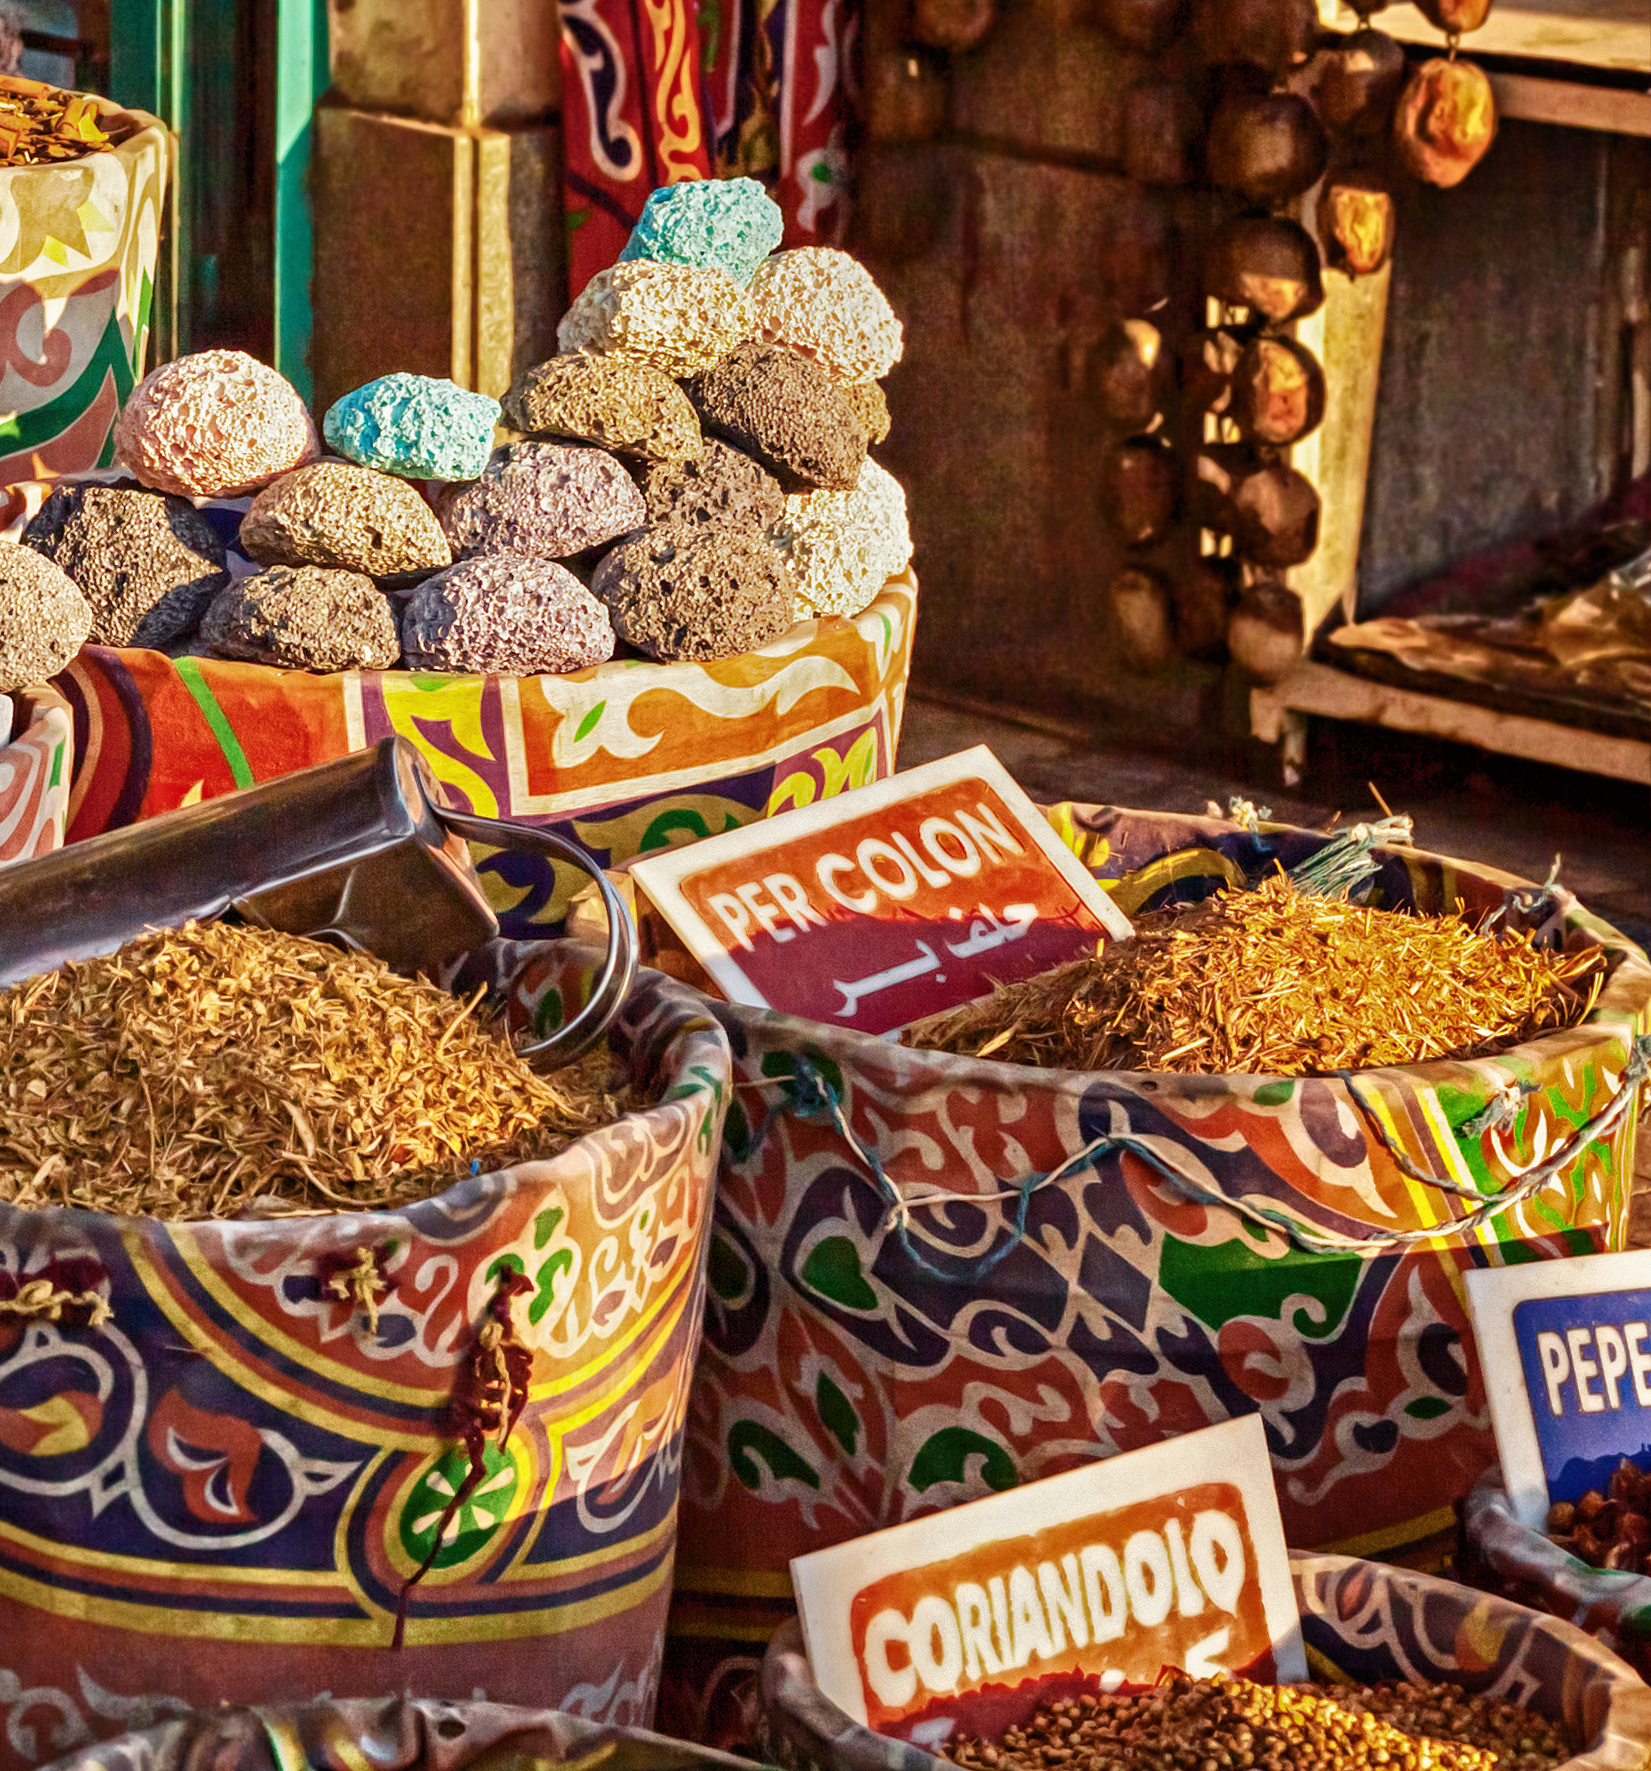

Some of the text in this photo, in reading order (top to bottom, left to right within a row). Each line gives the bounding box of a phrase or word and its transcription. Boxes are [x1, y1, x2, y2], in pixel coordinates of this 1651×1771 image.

[707, 802, 1026, 952] PER COLON
[1536, 1321, 1651, 1417] PEPE
